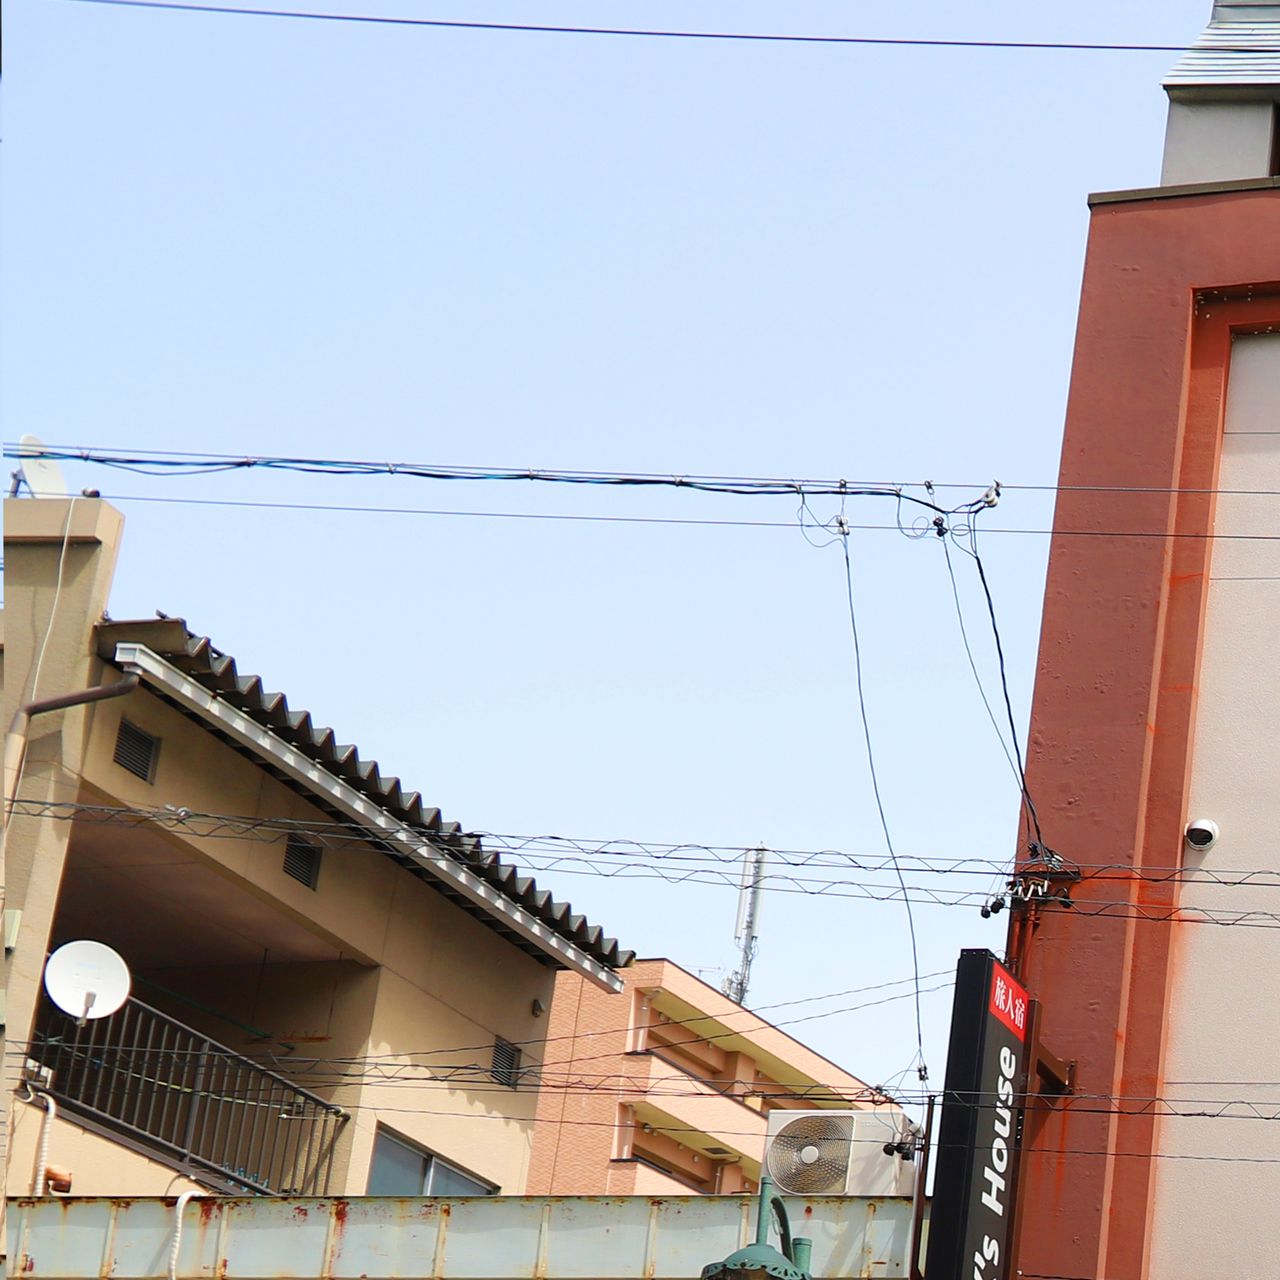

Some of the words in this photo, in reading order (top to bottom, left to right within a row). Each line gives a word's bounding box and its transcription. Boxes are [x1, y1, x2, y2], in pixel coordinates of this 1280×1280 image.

[995, 977, 1025, 1029] 旅人宿
[982, 1046, 1016, 1216] House
